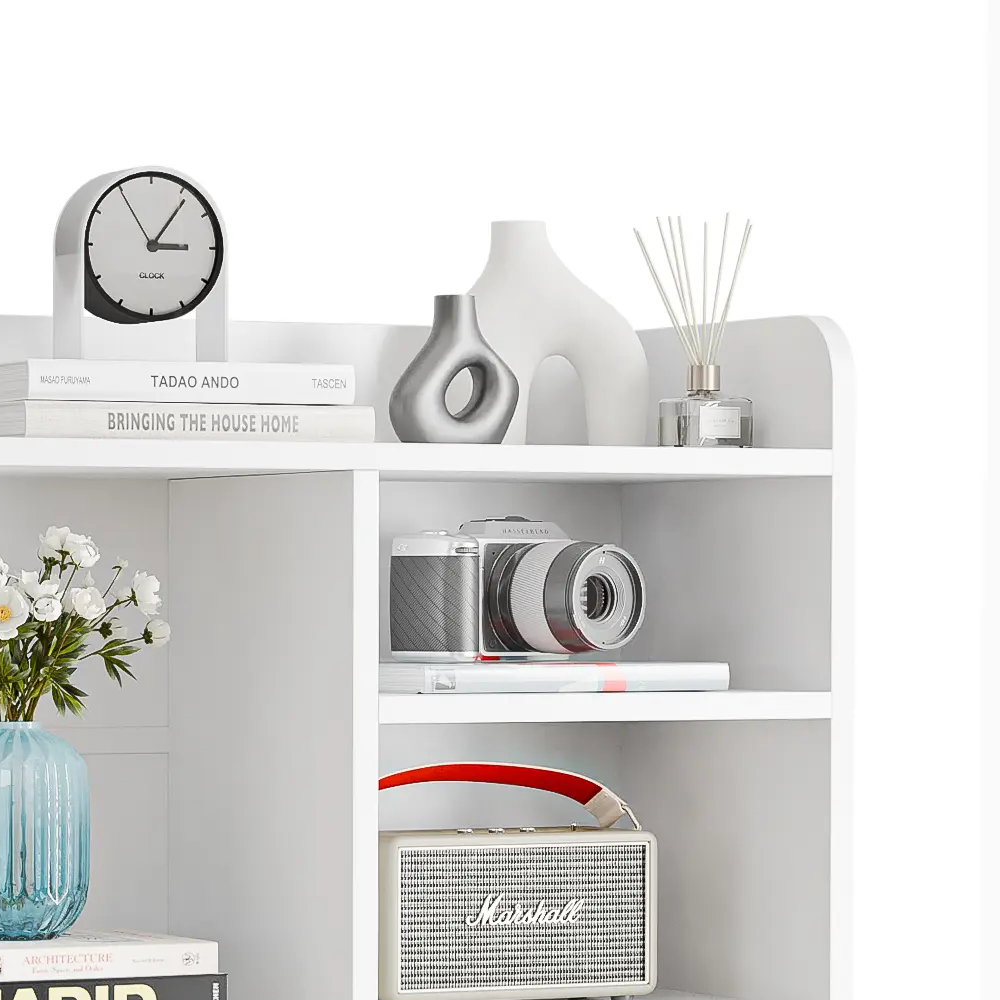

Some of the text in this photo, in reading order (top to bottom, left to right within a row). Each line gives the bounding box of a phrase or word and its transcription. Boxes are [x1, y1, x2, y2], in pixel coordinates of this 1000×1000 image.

[139, 272, 165, 280] CLOCK
[40, 375, 91, 385] MASAO FURUYAMA
[150, 375, 239, 389] TADAO ANDO
[311, 378, 347, 390] TASCEN
[107, 412, 299, 433] BRINGING THE HOUSE HOME
[465, 893, 585, 926] Marshall
[24, 952, 113, 965] ARCHITECTURE
